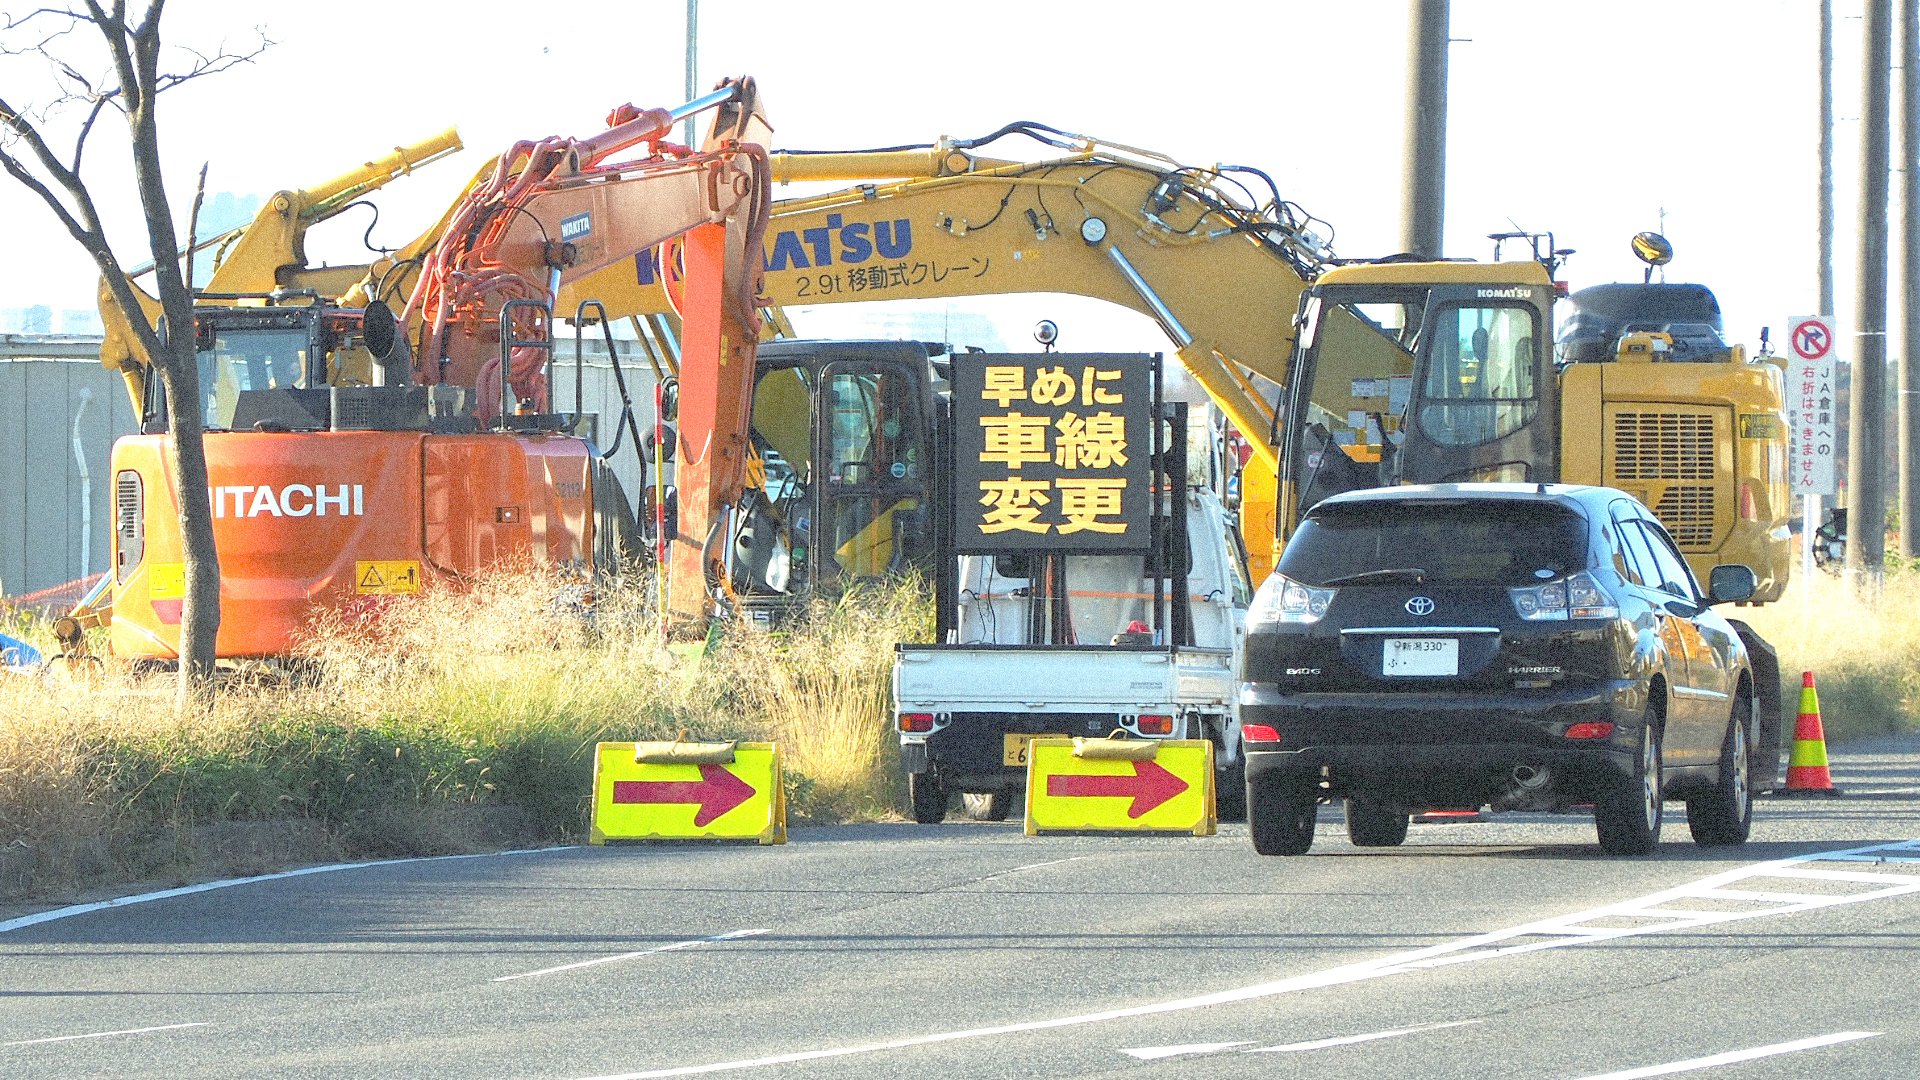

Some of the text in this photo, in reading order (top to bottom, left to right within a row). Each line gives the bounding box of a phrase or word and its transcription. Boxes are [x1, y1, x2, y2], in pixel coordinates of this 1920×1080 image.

[561, 216, 590, 237] WAKITA
[635, 213, 912, 286] KATSU
[847, 257, 991, 292] 移動式クレーン
[1477, 286, 1532, 298] KOMATSU
[981, 366, 1123, 408] 早めに
[1817, 367, 1831, 456] JA倉庫への
[979, 411, 1129, 469] 車線
[1800, 365, 1815, 487] 右折はできません
[978, 476, 1129, 535] 変更
